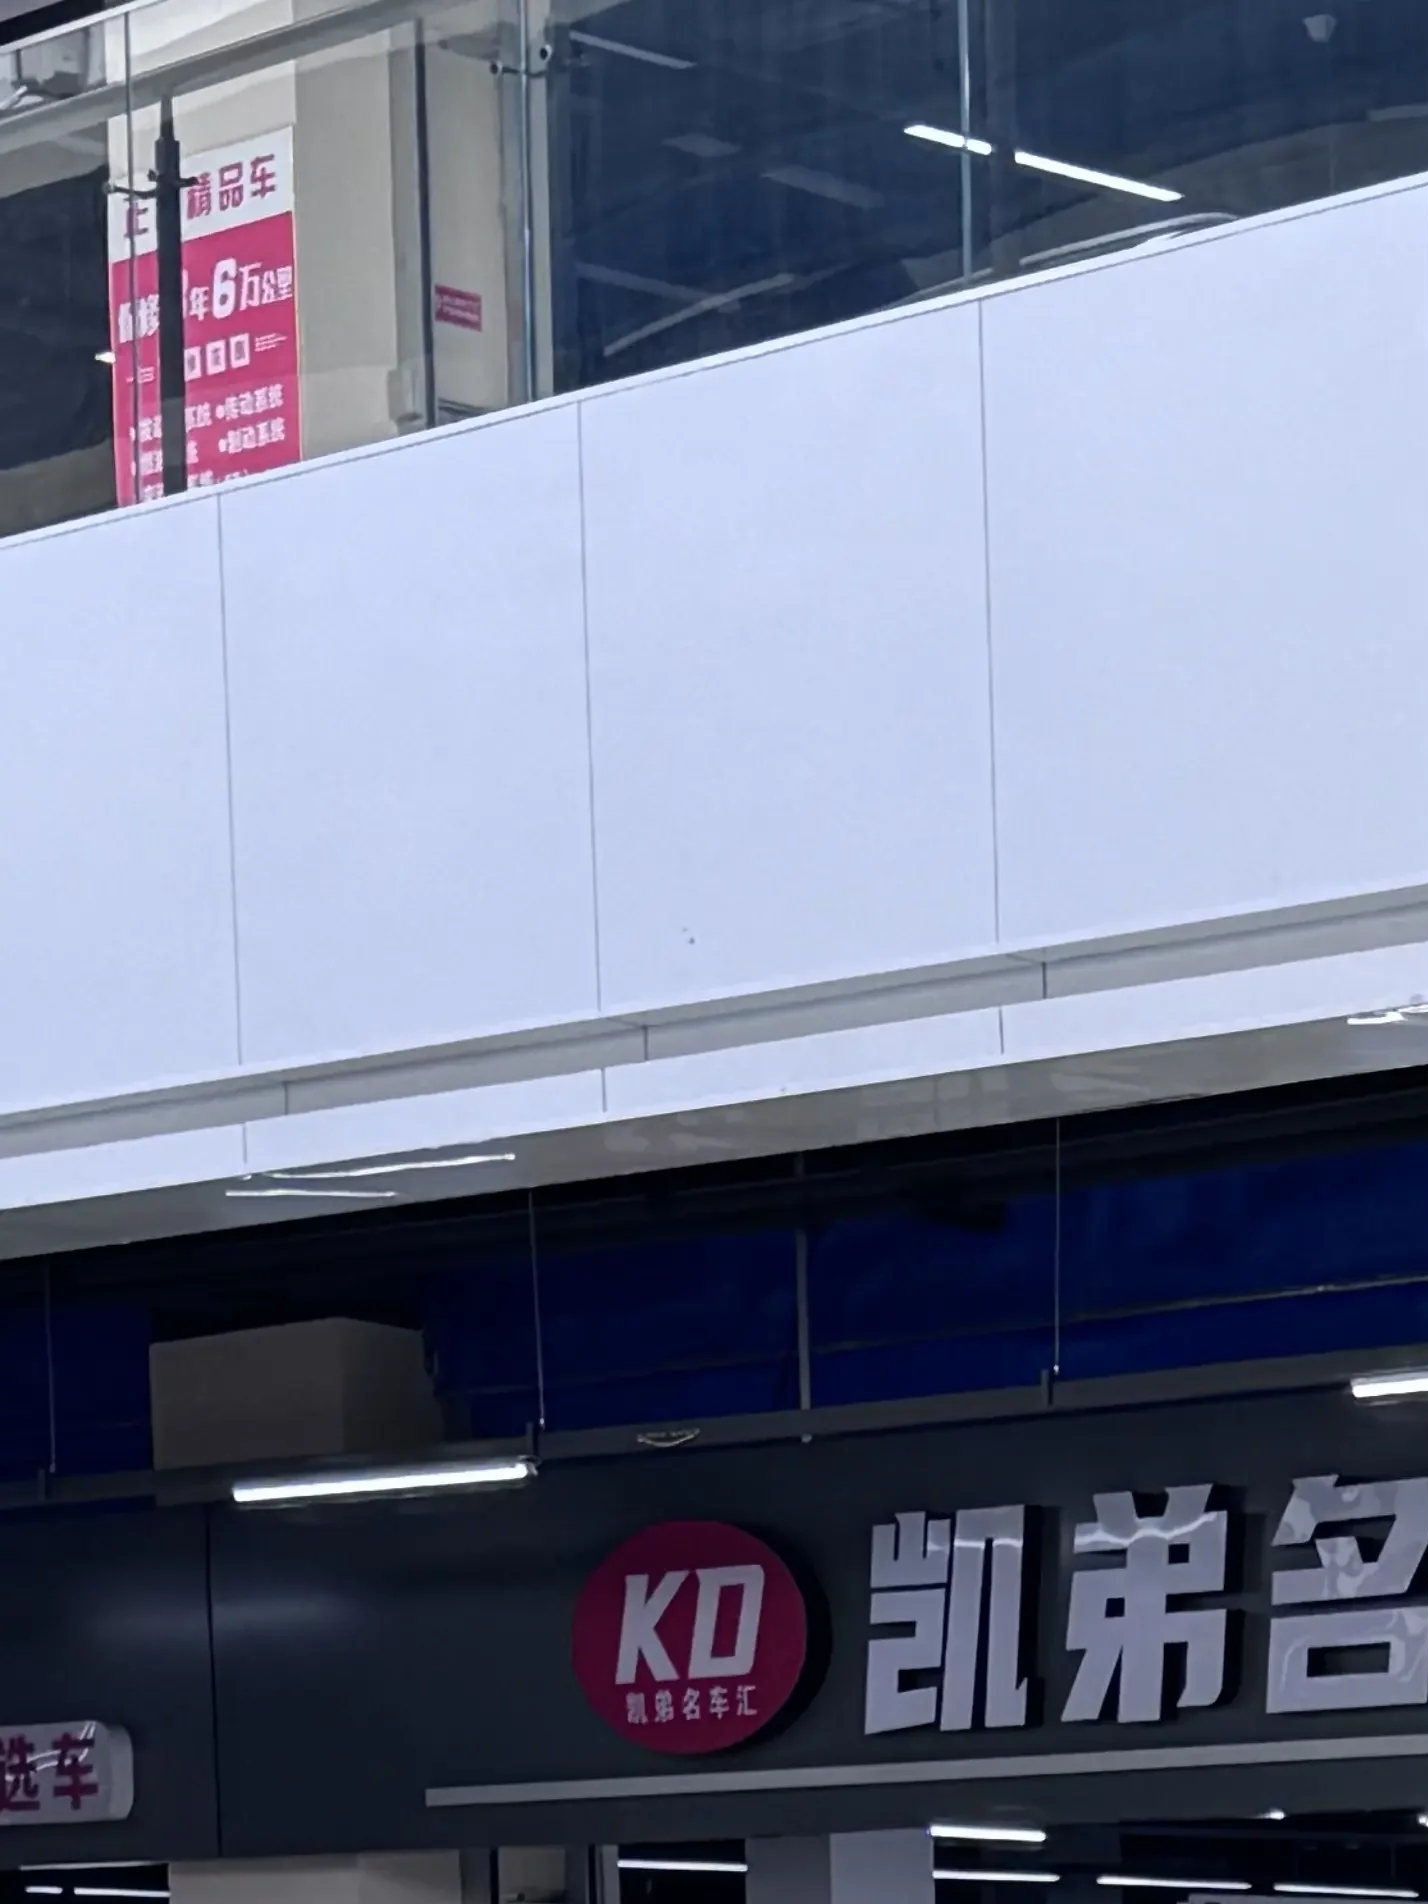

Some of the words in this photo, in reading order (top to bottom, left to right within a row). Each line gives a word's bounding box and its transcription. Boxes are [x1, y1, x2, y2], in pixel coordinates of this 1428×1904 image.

[615, 1564, 765, 1685] KD
[625, 1685, 758, 1725] 凯弟名车汇
